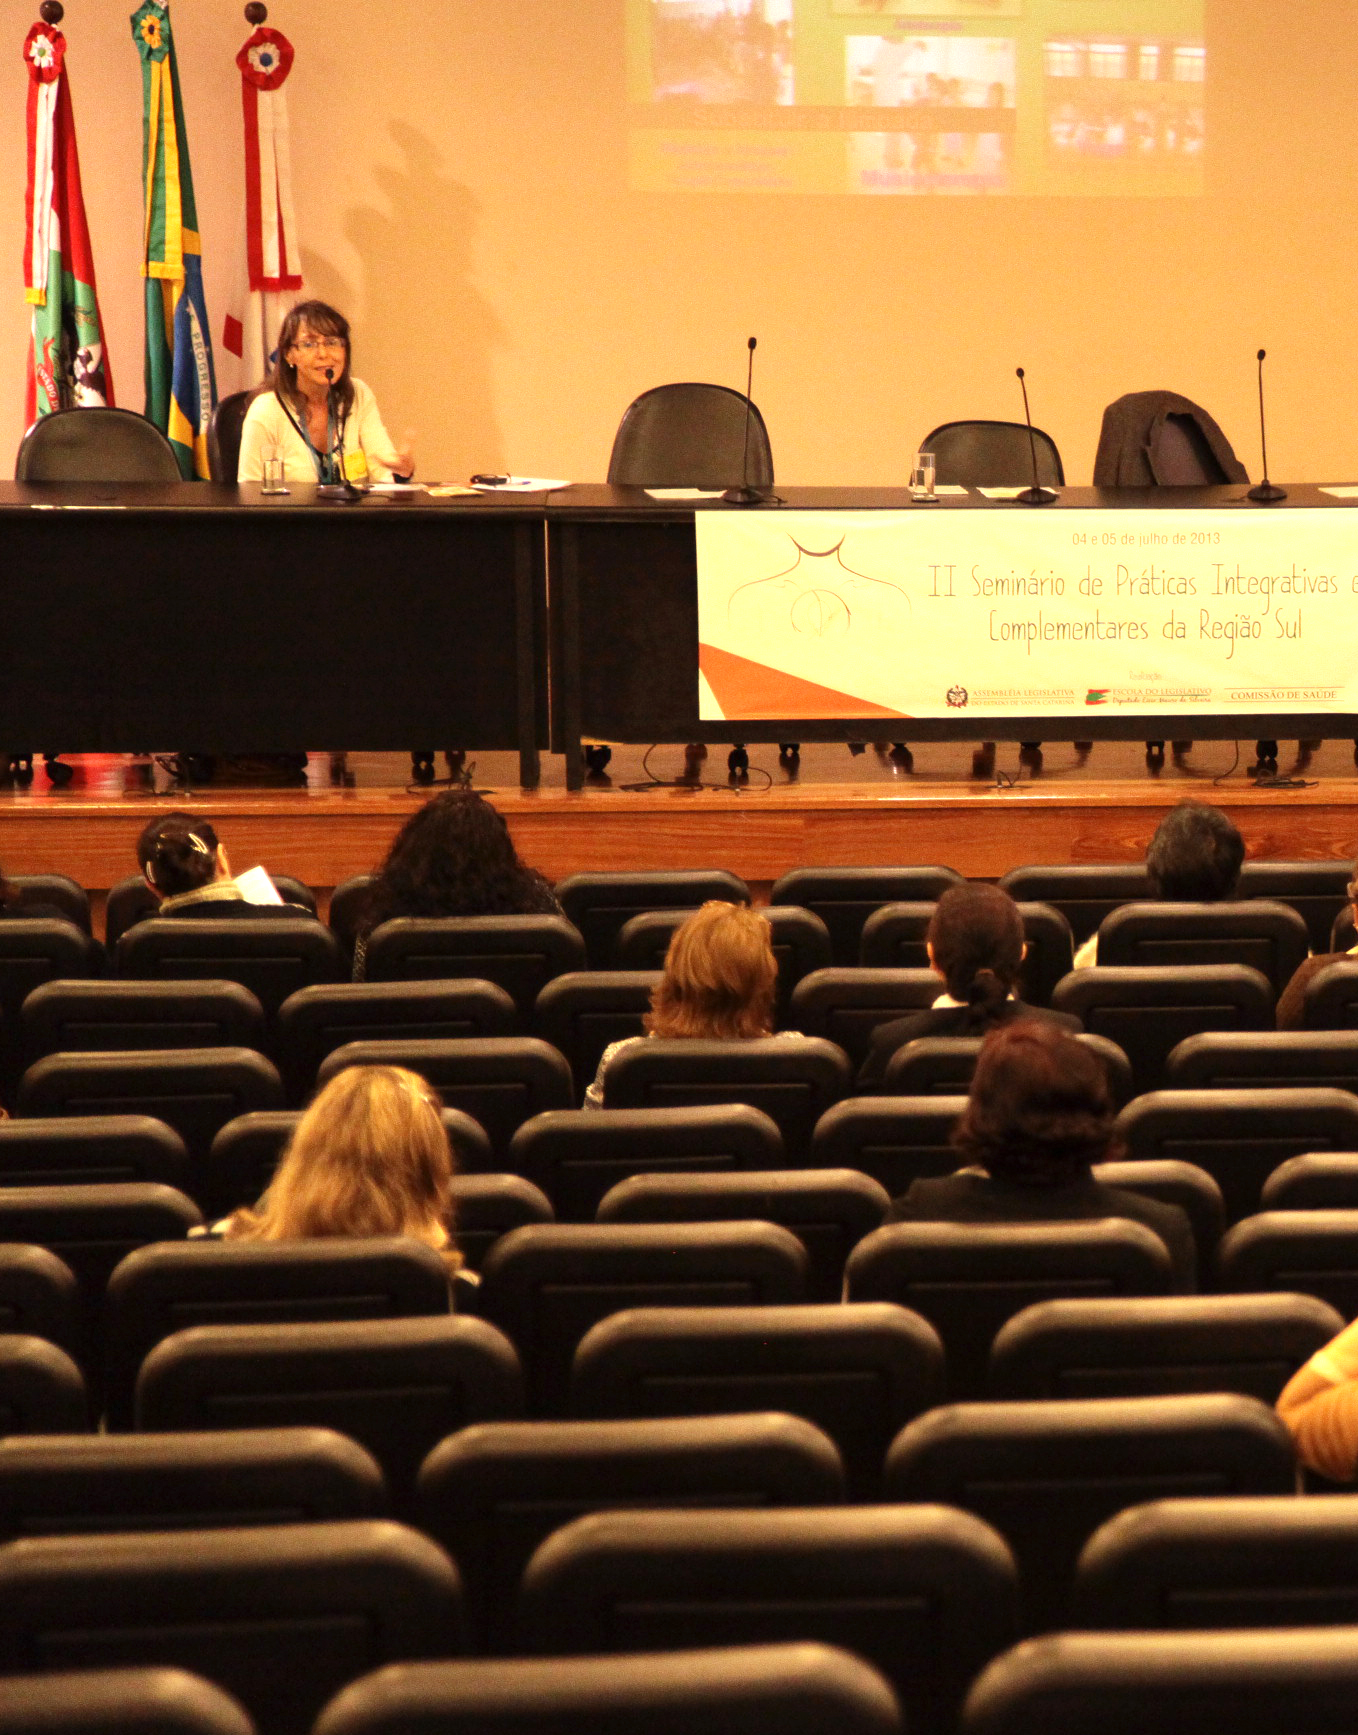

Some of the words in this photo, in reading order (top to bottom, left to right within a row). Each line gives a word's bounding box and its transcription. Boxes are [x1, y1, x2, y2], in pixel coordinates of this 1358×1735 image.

[192, 332, 210, 422] PROGRESSO
[1072, 532, 1087, 545] 04
[1091, 535, 1098, 545] e
[1101, 532, 1117, 545] 05
[1120, 533, 1135, 545] de
[1138, 533, 1169, 547] julho
[1172, 532, 1186, 545] de
[1190, 532, 1221, 545] 2013
[928, 564, 957, 597] II
[971, 564, 1065, 597] Seminário
[1078, 565, 1103, 597] de
[1116, 563, 1197, 596] Práticas
[1211, 563, 1338, 616] Integrativas
[989, 608, 1149, 656] Complementares
[1162, 609, 1186, 640] da
[1200, 608, 1261, 660] Região
[1275, 607, 1302, 639] Sul
[1112, 688, 1143, 696] ESCOLA
[1145, 688, 1158, 696] DO
[1161, 687, 1212, 696] LEGISLATIVO
[1231, 689, 1284, 700] COMISSÃO
[1287, 690, 1301, 700] DE
[1303, 689, 1337, 700] SAÚDE
